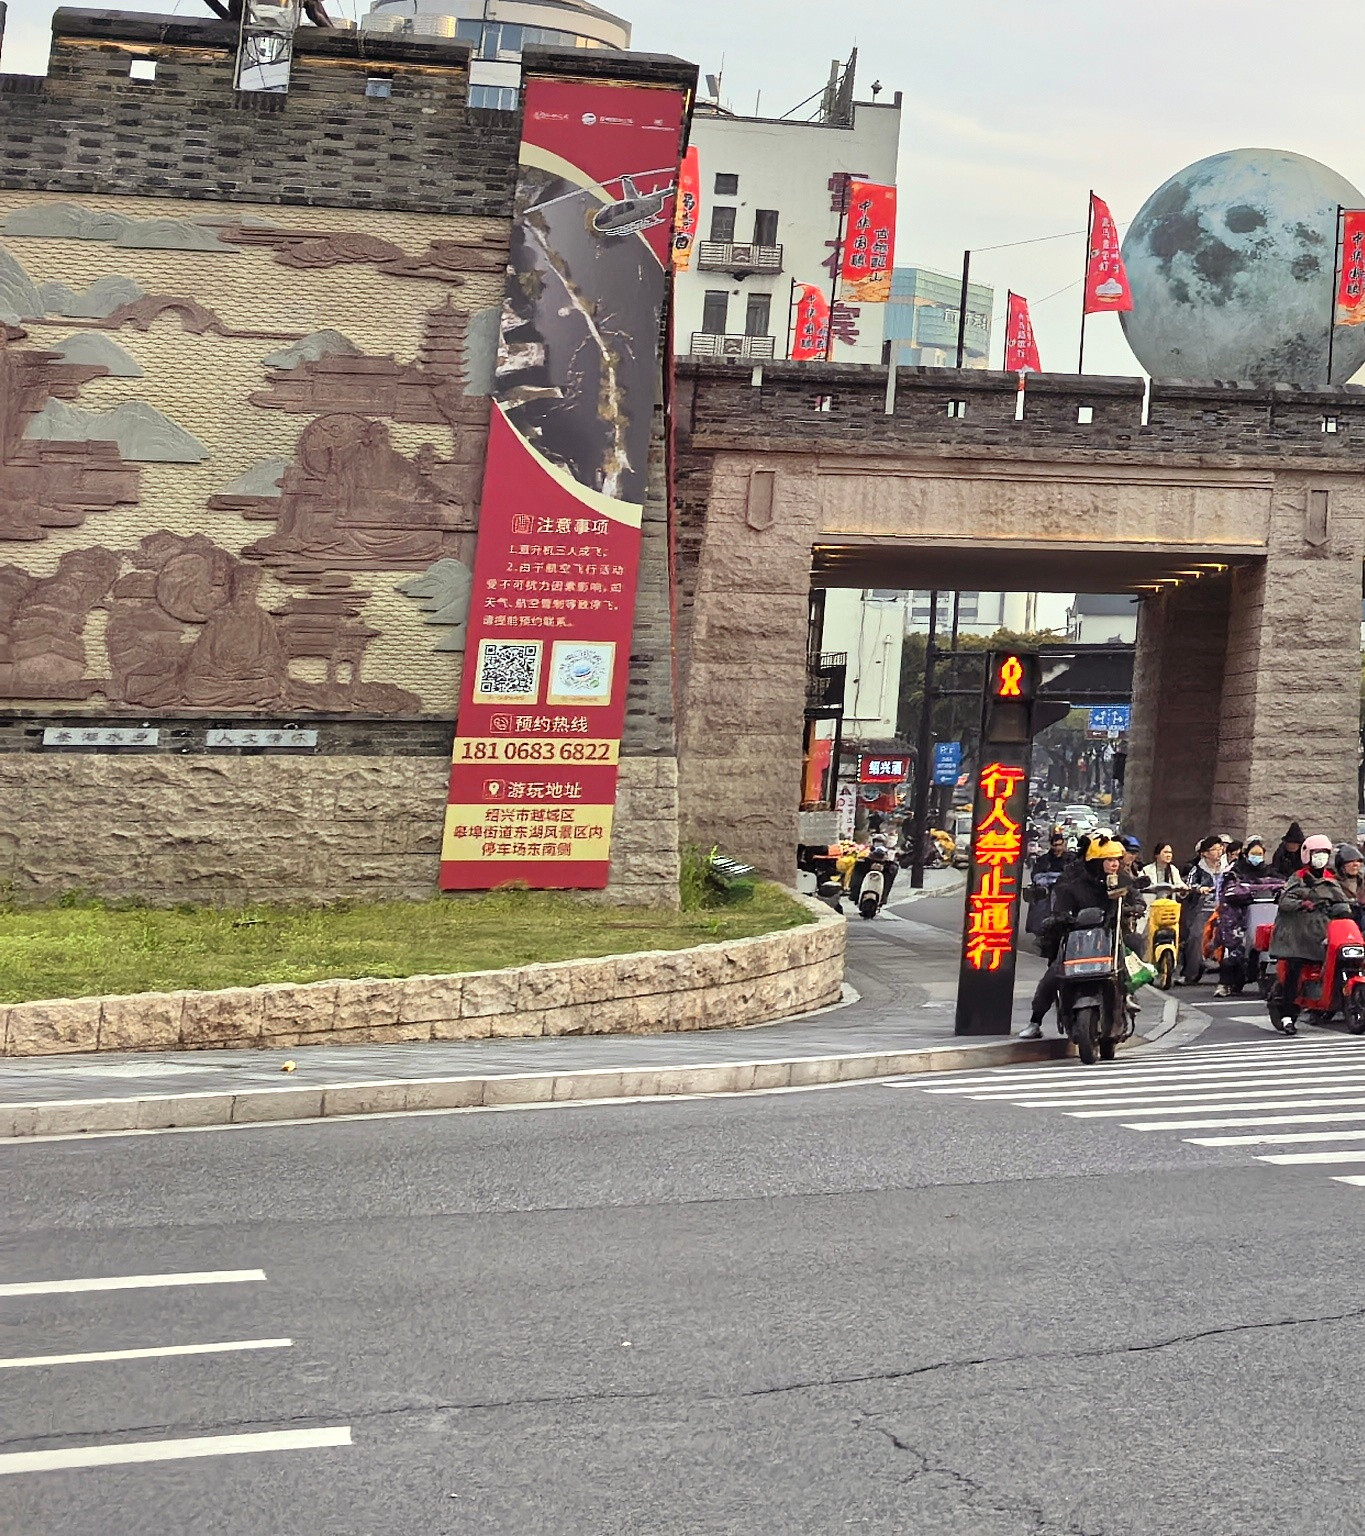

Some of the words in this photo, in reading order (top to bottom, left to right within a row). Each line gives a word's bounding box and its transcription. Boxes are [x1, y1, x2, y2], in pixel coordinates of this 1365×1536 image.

[537, 516, 610, 536] 注意事项
[514, 715, 589, 733] 预约热线
[461, 742, 498, 759] 181
[504, 742, 555, 760] 0683
[559, 742, 611, 761] 6822
[507, 781, 583, 799] 游玩地址
[966, 762, 1025, 972] 行人禁止通行
